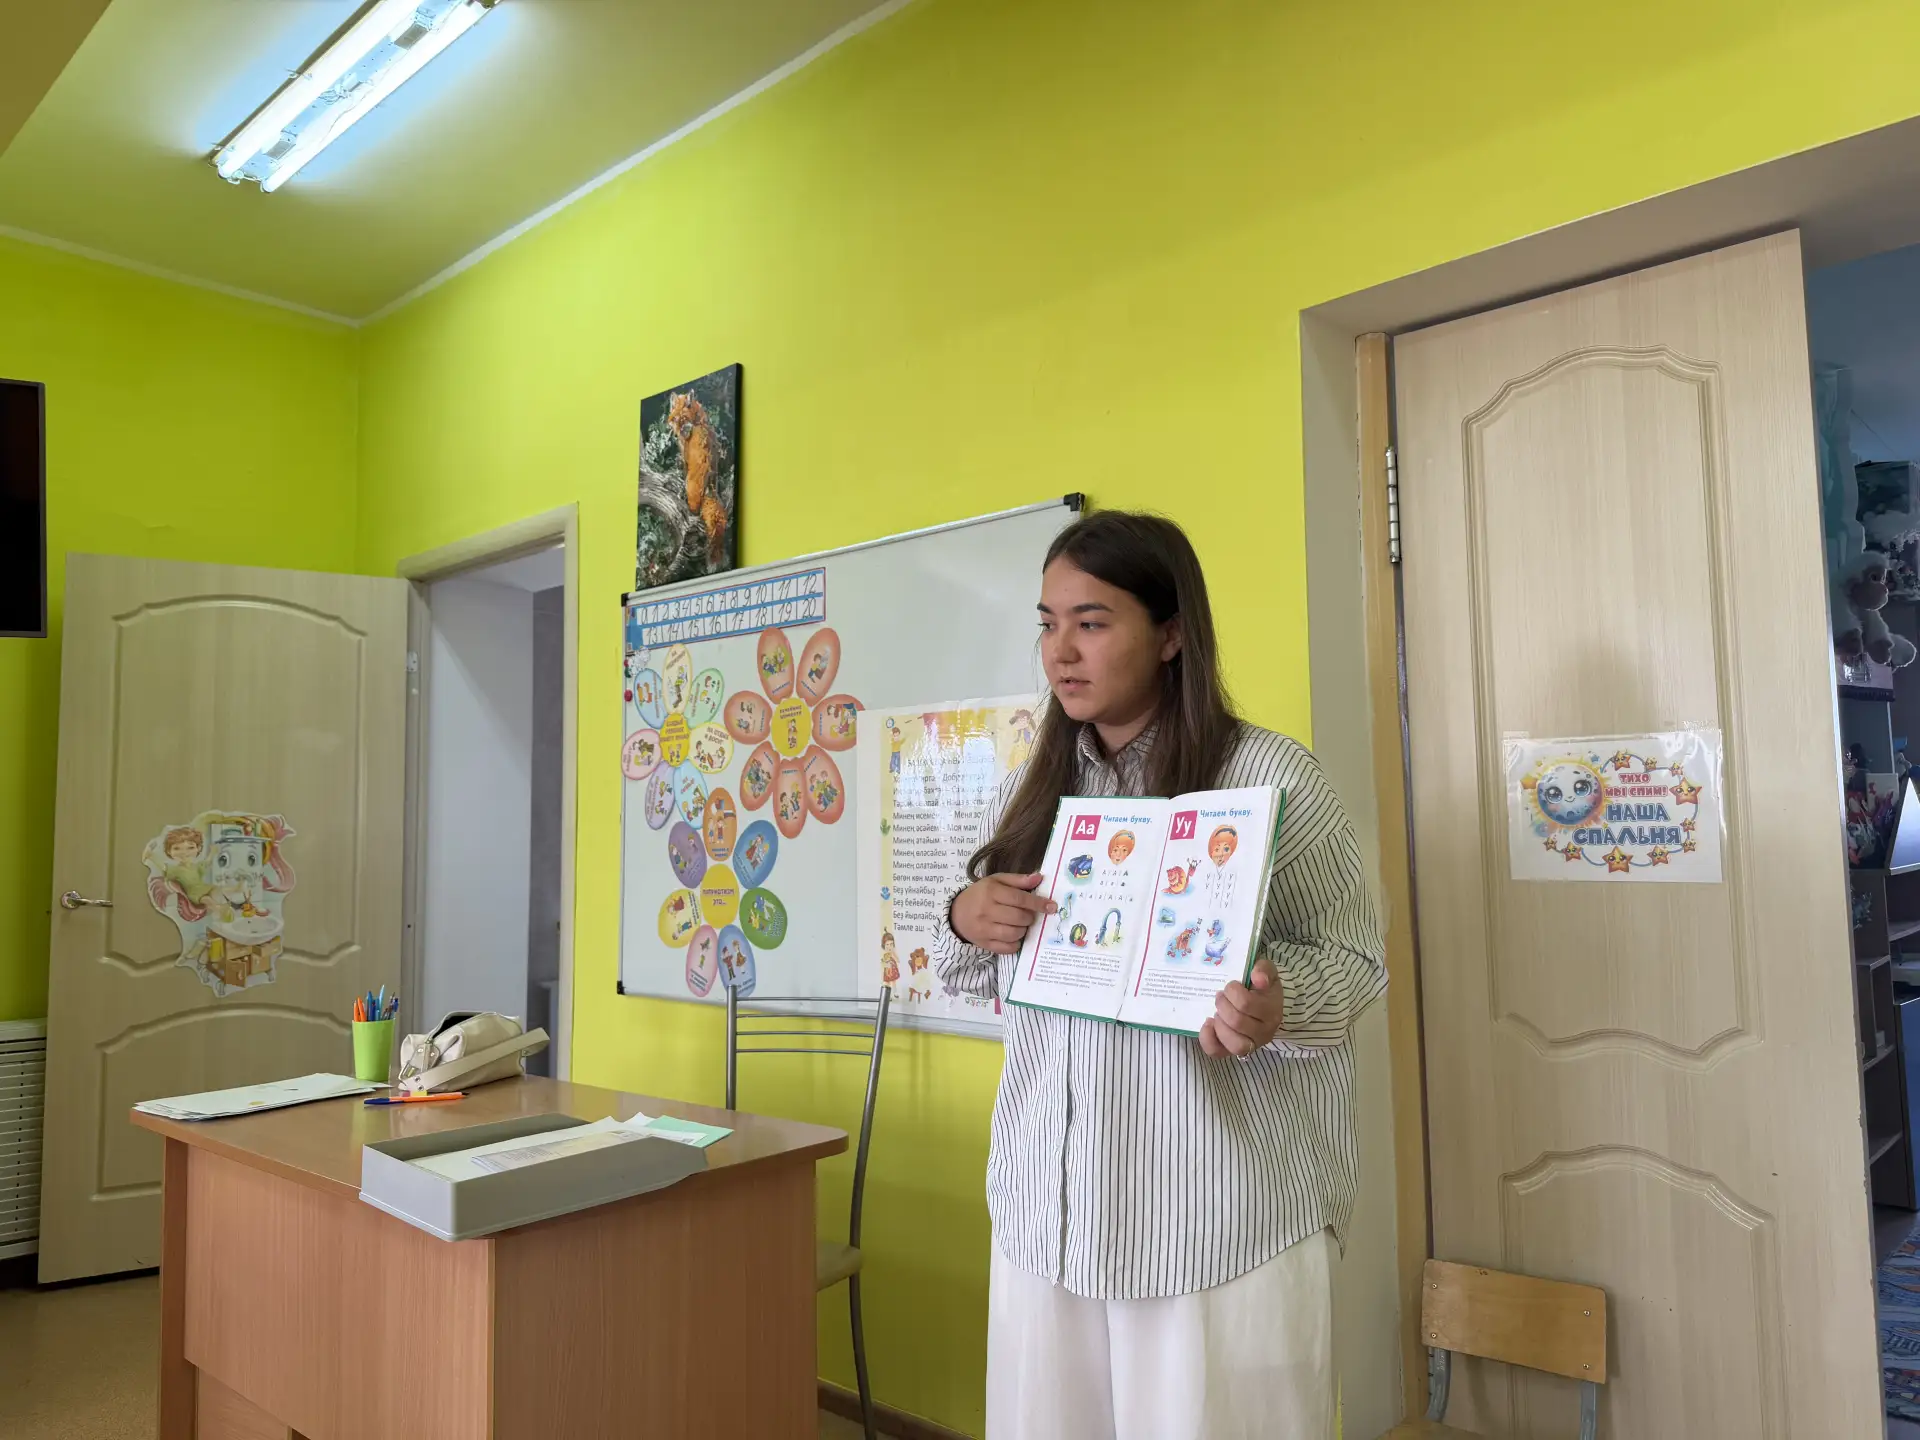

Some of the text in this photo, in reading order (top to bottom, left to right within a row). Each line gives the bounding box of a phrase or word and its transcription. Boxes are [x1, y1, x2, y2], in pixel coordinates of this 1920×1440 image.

[641, 574, 817, 624] 0 1 2 3 4 5 6 7 8 9 10 11 12
[646, 597, 816, 644] 13 14 15 16 17 18 19 20
[1619, 773, 1650, 783] ТИХО
[1605, 786, 1668, 797] МЫ СПИМ!
[1229, 808, 1253, 818] букву.
[1607, 803, 1670, 822] НАША
[1130, 815, 1152, 824] букву.
[1076, 820, 1096, 835] Аа
[1176, 816, 1192, 838] Уу
[893, 837, 915, 845] Минең
[1572, 826, 1681, 845] СПАЛЬНЯ
[893, 849, 915, 858] Минең
[893, 861, 915, 870] Минең
